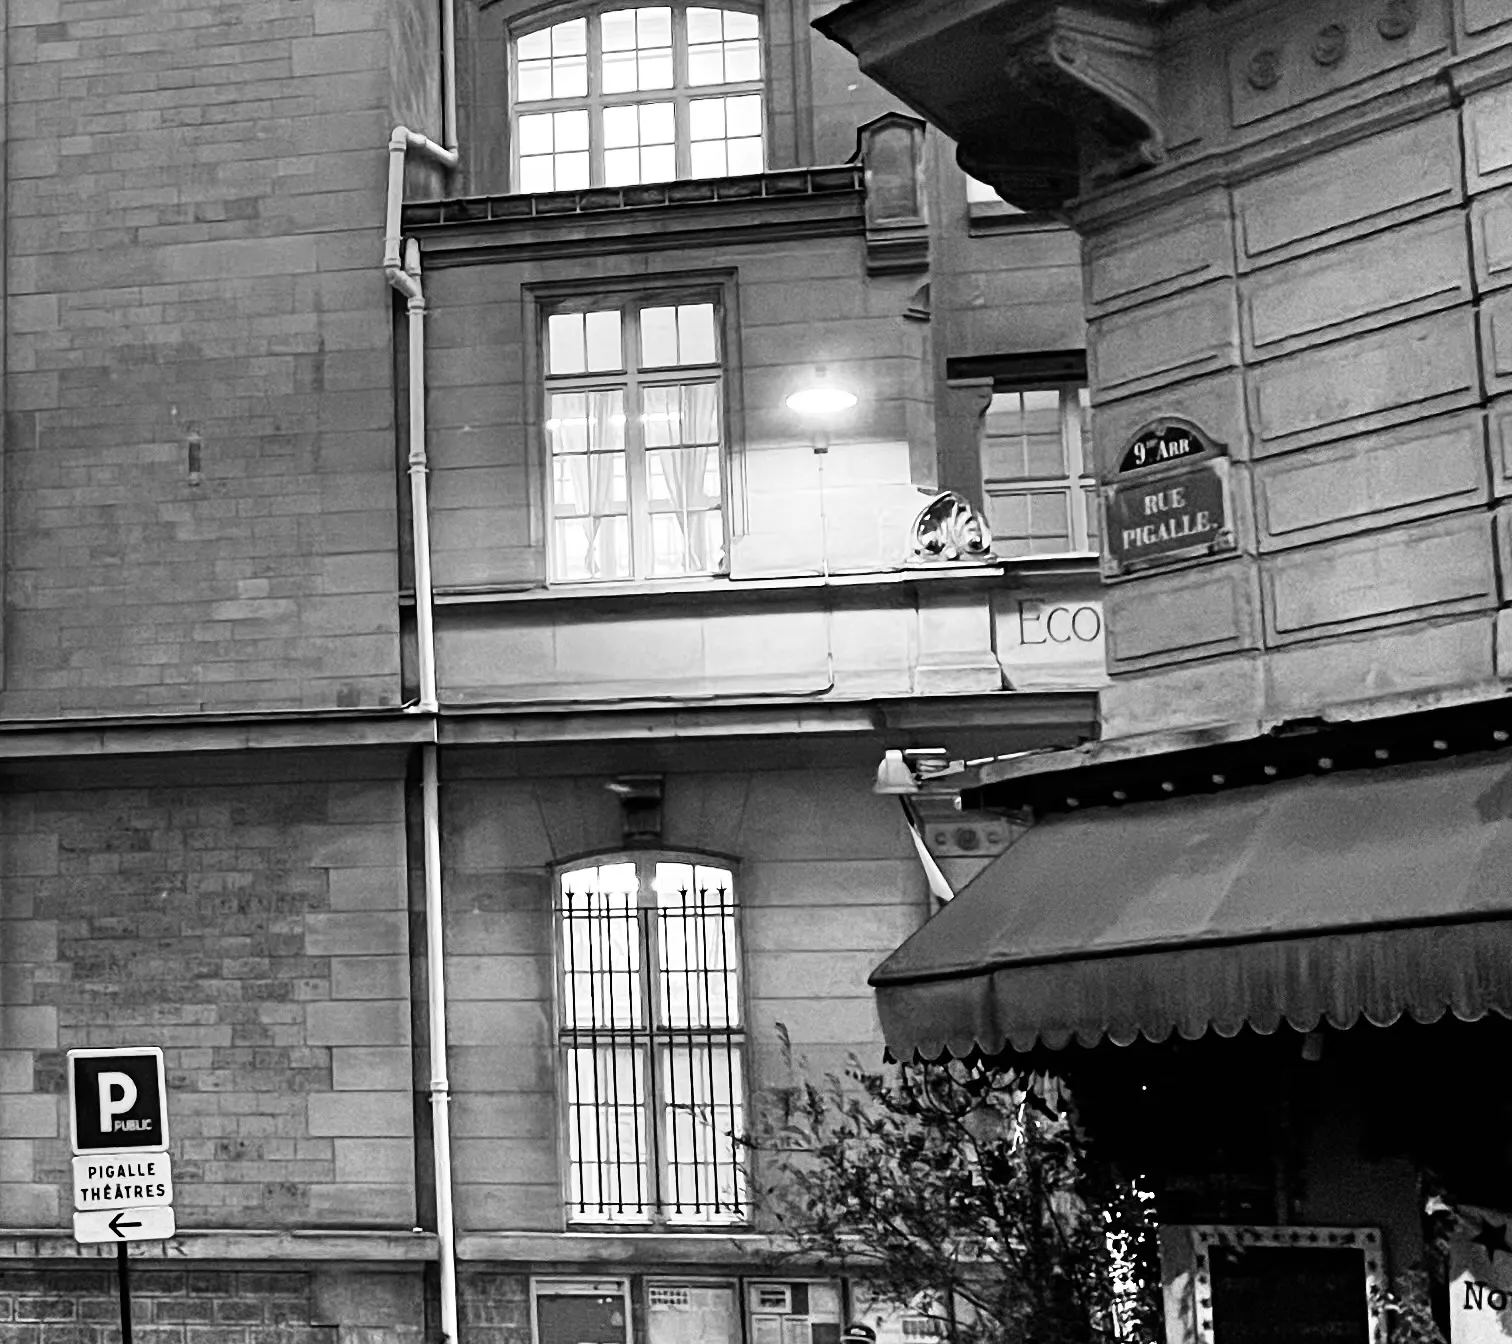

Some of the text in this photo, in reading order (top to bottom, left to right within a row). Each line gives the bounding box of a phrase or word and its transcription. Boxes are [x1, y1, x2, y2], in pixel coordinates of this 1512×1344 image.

[1144, 487, 1187, 516] RUE
[97, 1071, 138, 1133] P
[114, 1119, 153, 1132] PUBLIC
[88, 1162, 156, 1180] PIGALLE
